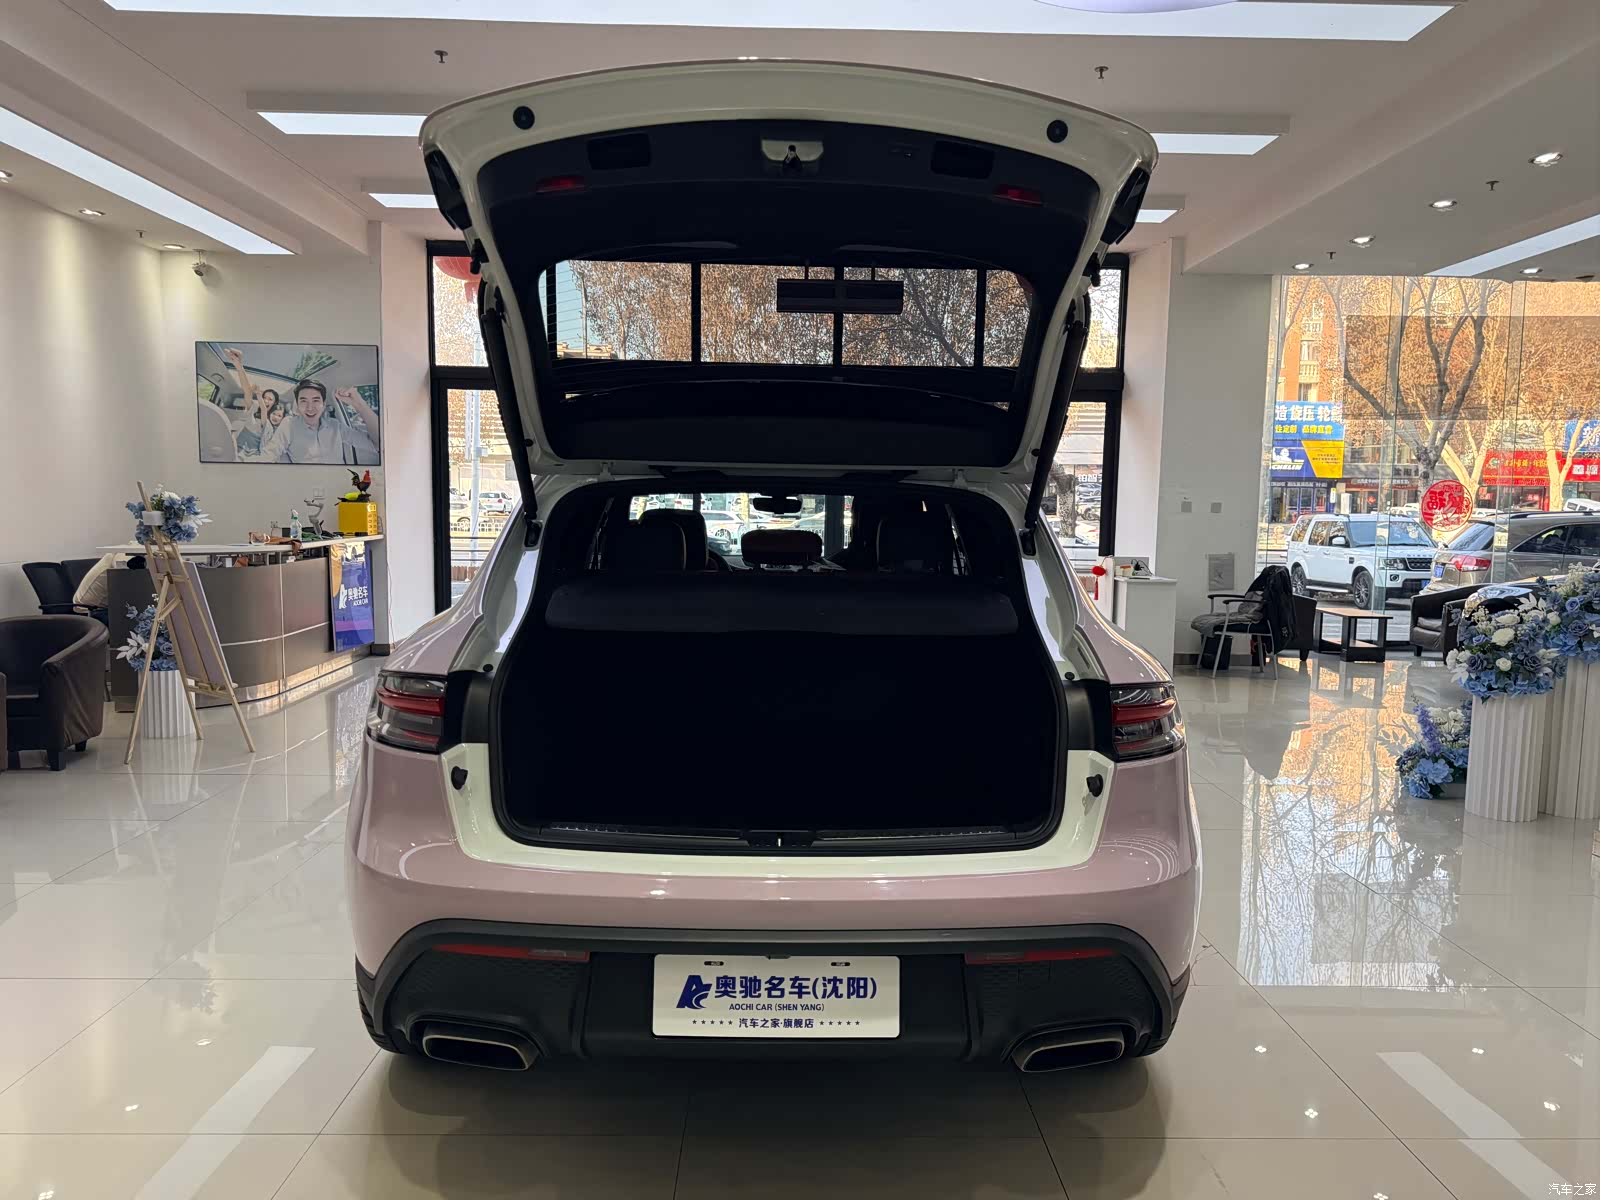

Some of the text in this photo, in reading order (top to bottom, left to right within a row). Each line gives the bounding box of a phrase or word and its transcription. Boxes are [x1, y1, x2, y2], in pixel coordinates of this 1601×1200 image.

[715, 975, 877, 999] 奥驰名车(沈阳)
[729, 1003, 825, 1012] AOCHI CAR (SHEN YANG)
